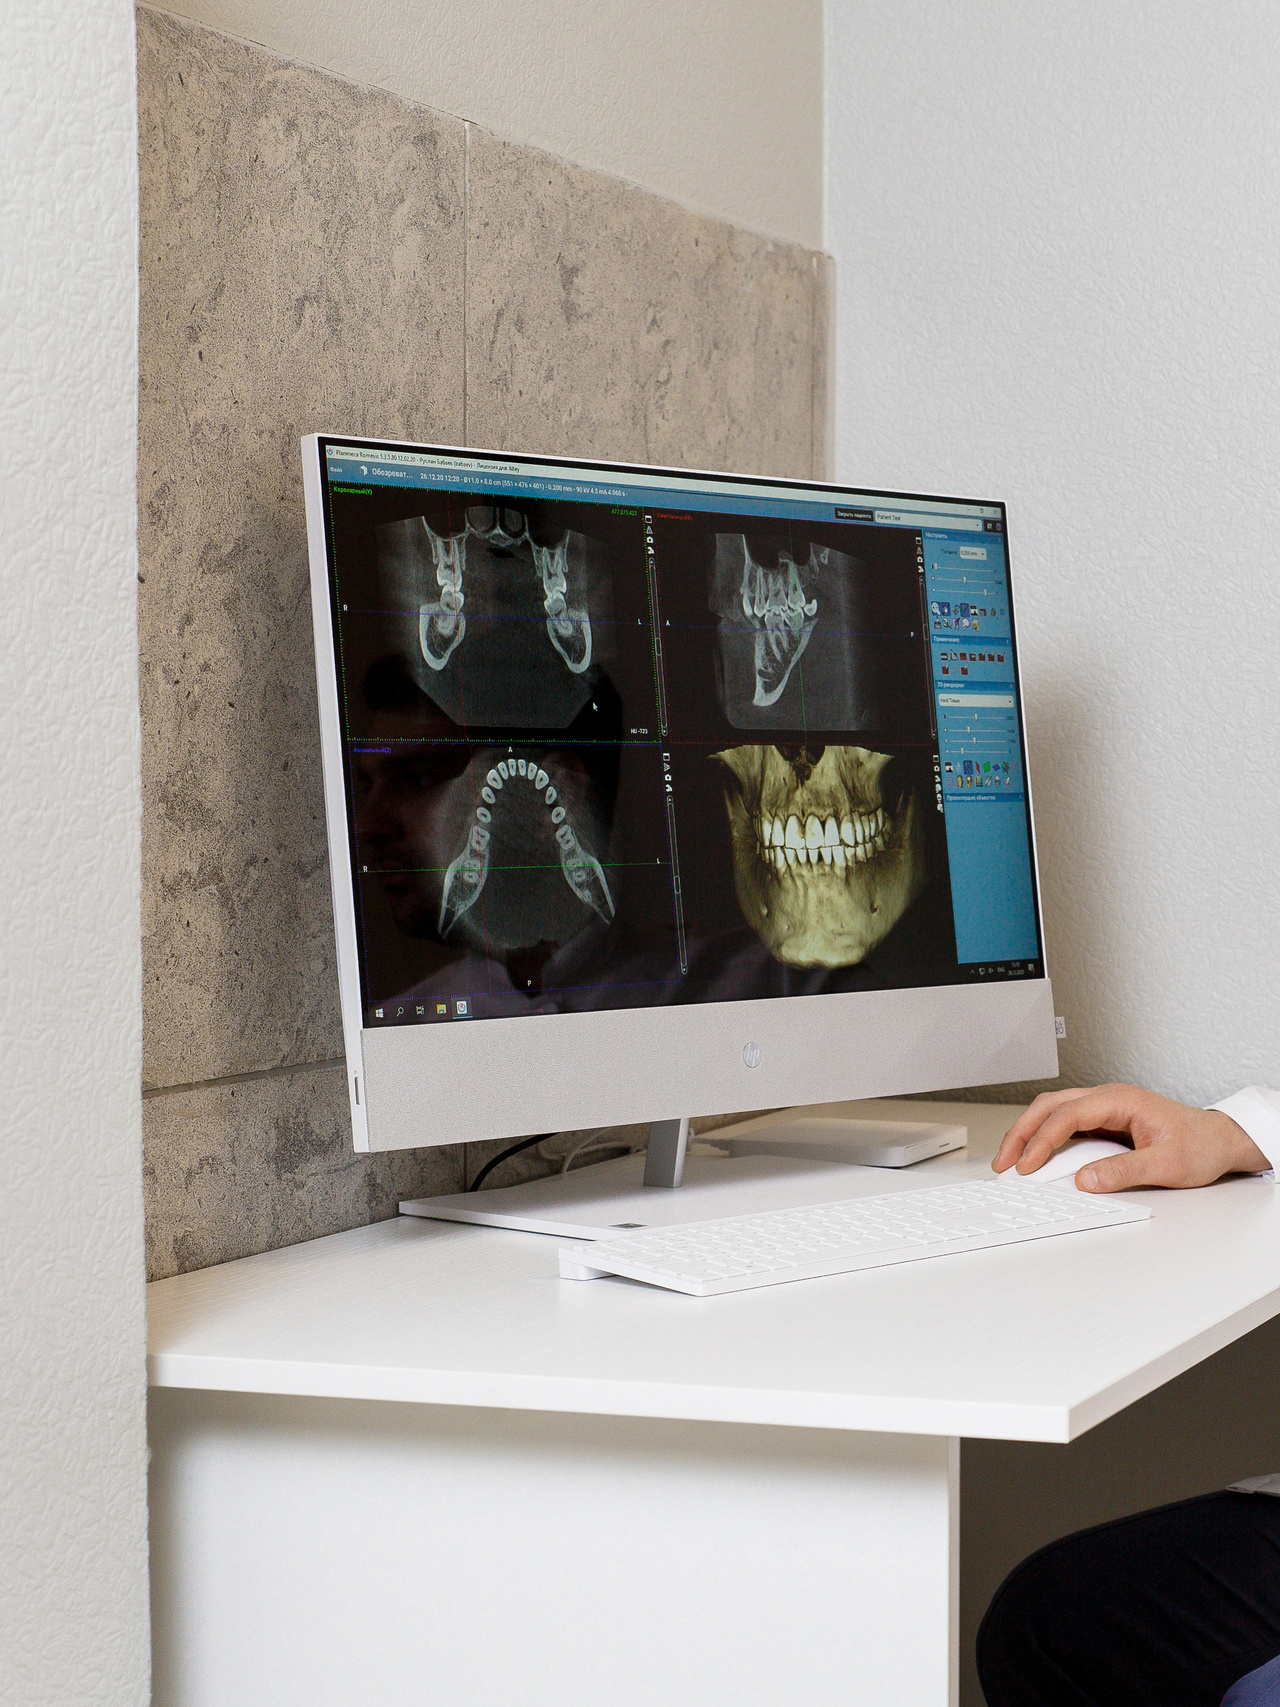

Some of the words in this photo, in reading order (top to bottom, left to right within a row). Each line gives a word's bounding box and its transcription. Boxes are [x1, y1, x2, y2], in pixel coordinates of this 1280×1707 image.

[336, 449, 359, 458] Planmeca
[360, 451, 379, 460] Romexis
[420, 457, 436, 465] Руслан
[372, 467, 413, 479] Обозреват...
[420, 472, 444, 481] 26.12.20
[445, 474, 460, 482] 12:20
[502, 480, 513, 488] (551
[744, 1042, 762, 1068] hp
